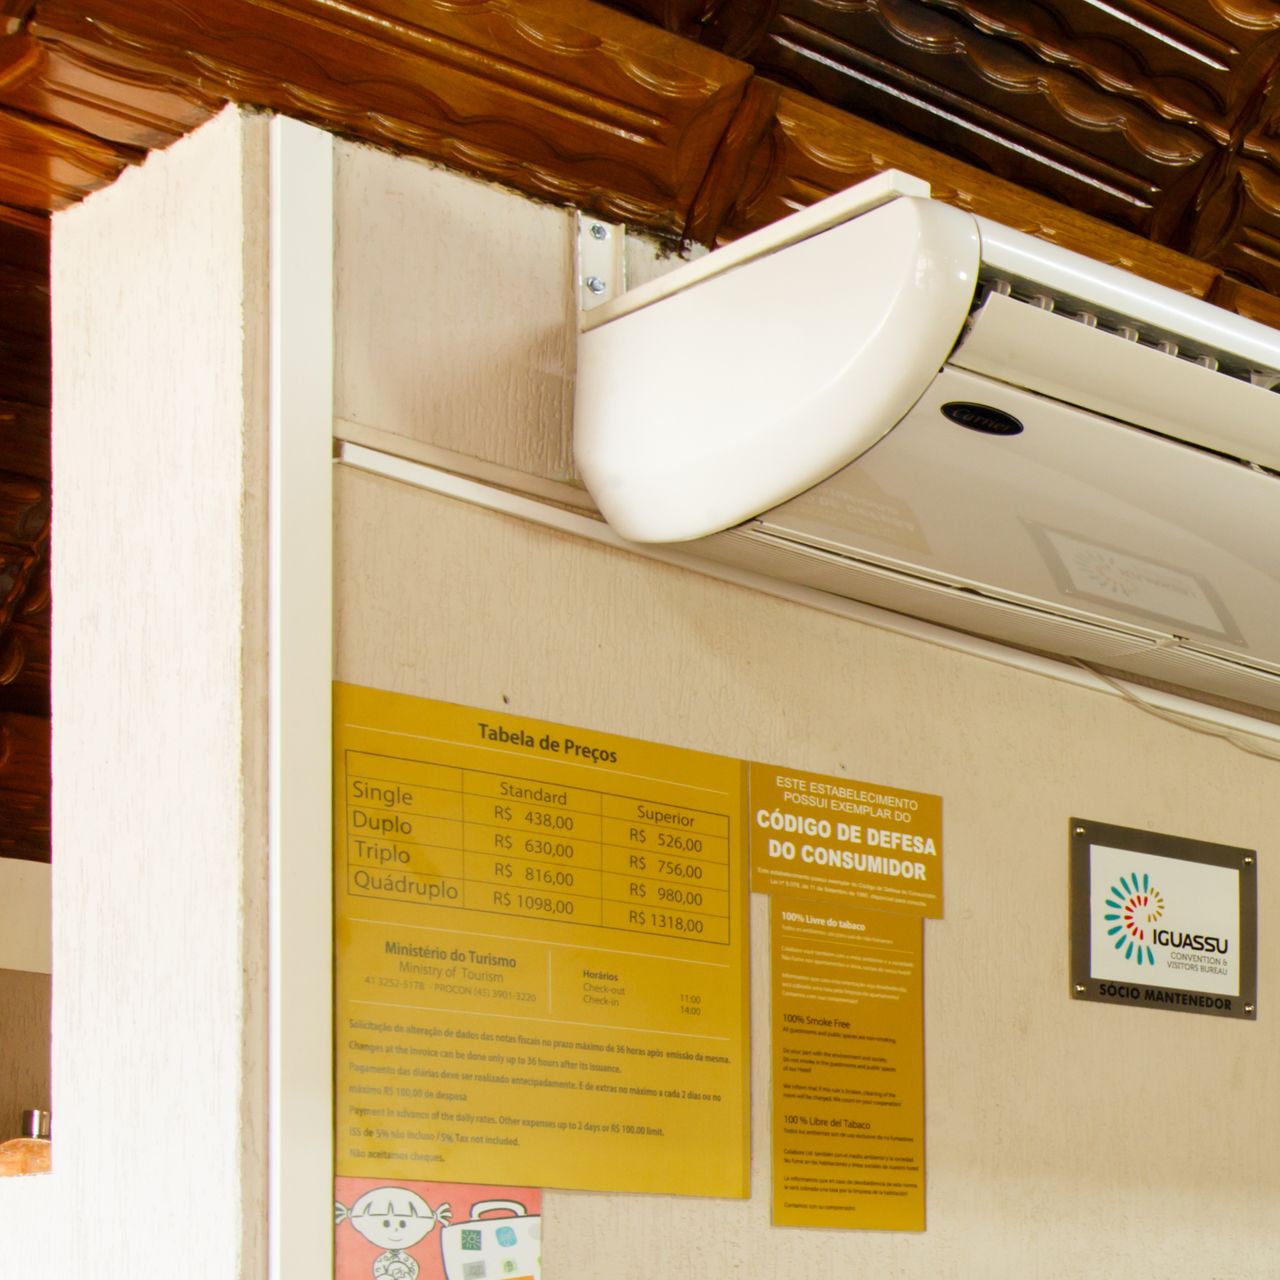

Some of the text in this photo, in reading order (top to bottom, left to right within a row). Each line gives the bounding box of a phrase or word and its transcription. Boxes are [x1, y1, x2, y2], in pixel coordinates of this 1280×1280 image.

[478, 722, 618, 763] Tabela de Preços
[352, 781, 413, 807] Single
[500, 781, 567, 806] Standard
[776, 776, 918, 811] ESTE ESTABELECIMENTO
[494, 805, 573, 832] R$ 438,00
[637, 805, 694, 828] Superior
[784, 791, 911, 823] POSSUI EXEMPLAR DO
[352, 809, 412, 835] Duplo
[757, 808, 936, 856] CÓDIGO DE DEFESA
[354, 839, 410, 864] Triplo
[494, 833, 573, 859] R$ 630,00
[630, 828, 702, 854] R$ 526,00
[630, 855, 702, 880] R$ 756,00
[768, 839, 926, 881] DO CONSUMIDOR
[354, 870, 458, 899] Quádruplo
[495, 862, 573, 887] R$ 816,00
[493, 891, 573, 916] R$ 1098,00
[630, 882, 702, 907] R$ 980,00
[629, 910, 703, 935] R$ 1318,00
[782, 912, 865, 931] 100% Livre do tabaco
[1153, 929, 1228, 954] IGUASSU
[385, 941, 516, 968] Ministério do Turismo
[1171, 952, 1220, 965] CONVENTION
[400, 962, 503, 983] Ministry of Tourism
[584, 970, 618, 981] Horários
[1167, 961, 1227, 976] VISITORS BUREAU
[434, 984, 472, 995] PROCON
[584, 982, 625, 995] Check-out
[584, 995, 619, 1006] Check-in
[681, 994, 701, 1004] 11:00
[1099, 982, 1232, 1010] SÓCIO MANTENEDOR
[681, 1006, 701, 1016] 14:00
[783, 1013, 850, 1029] 100% Smoke Free
[784, 1115, 870, 1129] 100 % Libre del Tabaco
